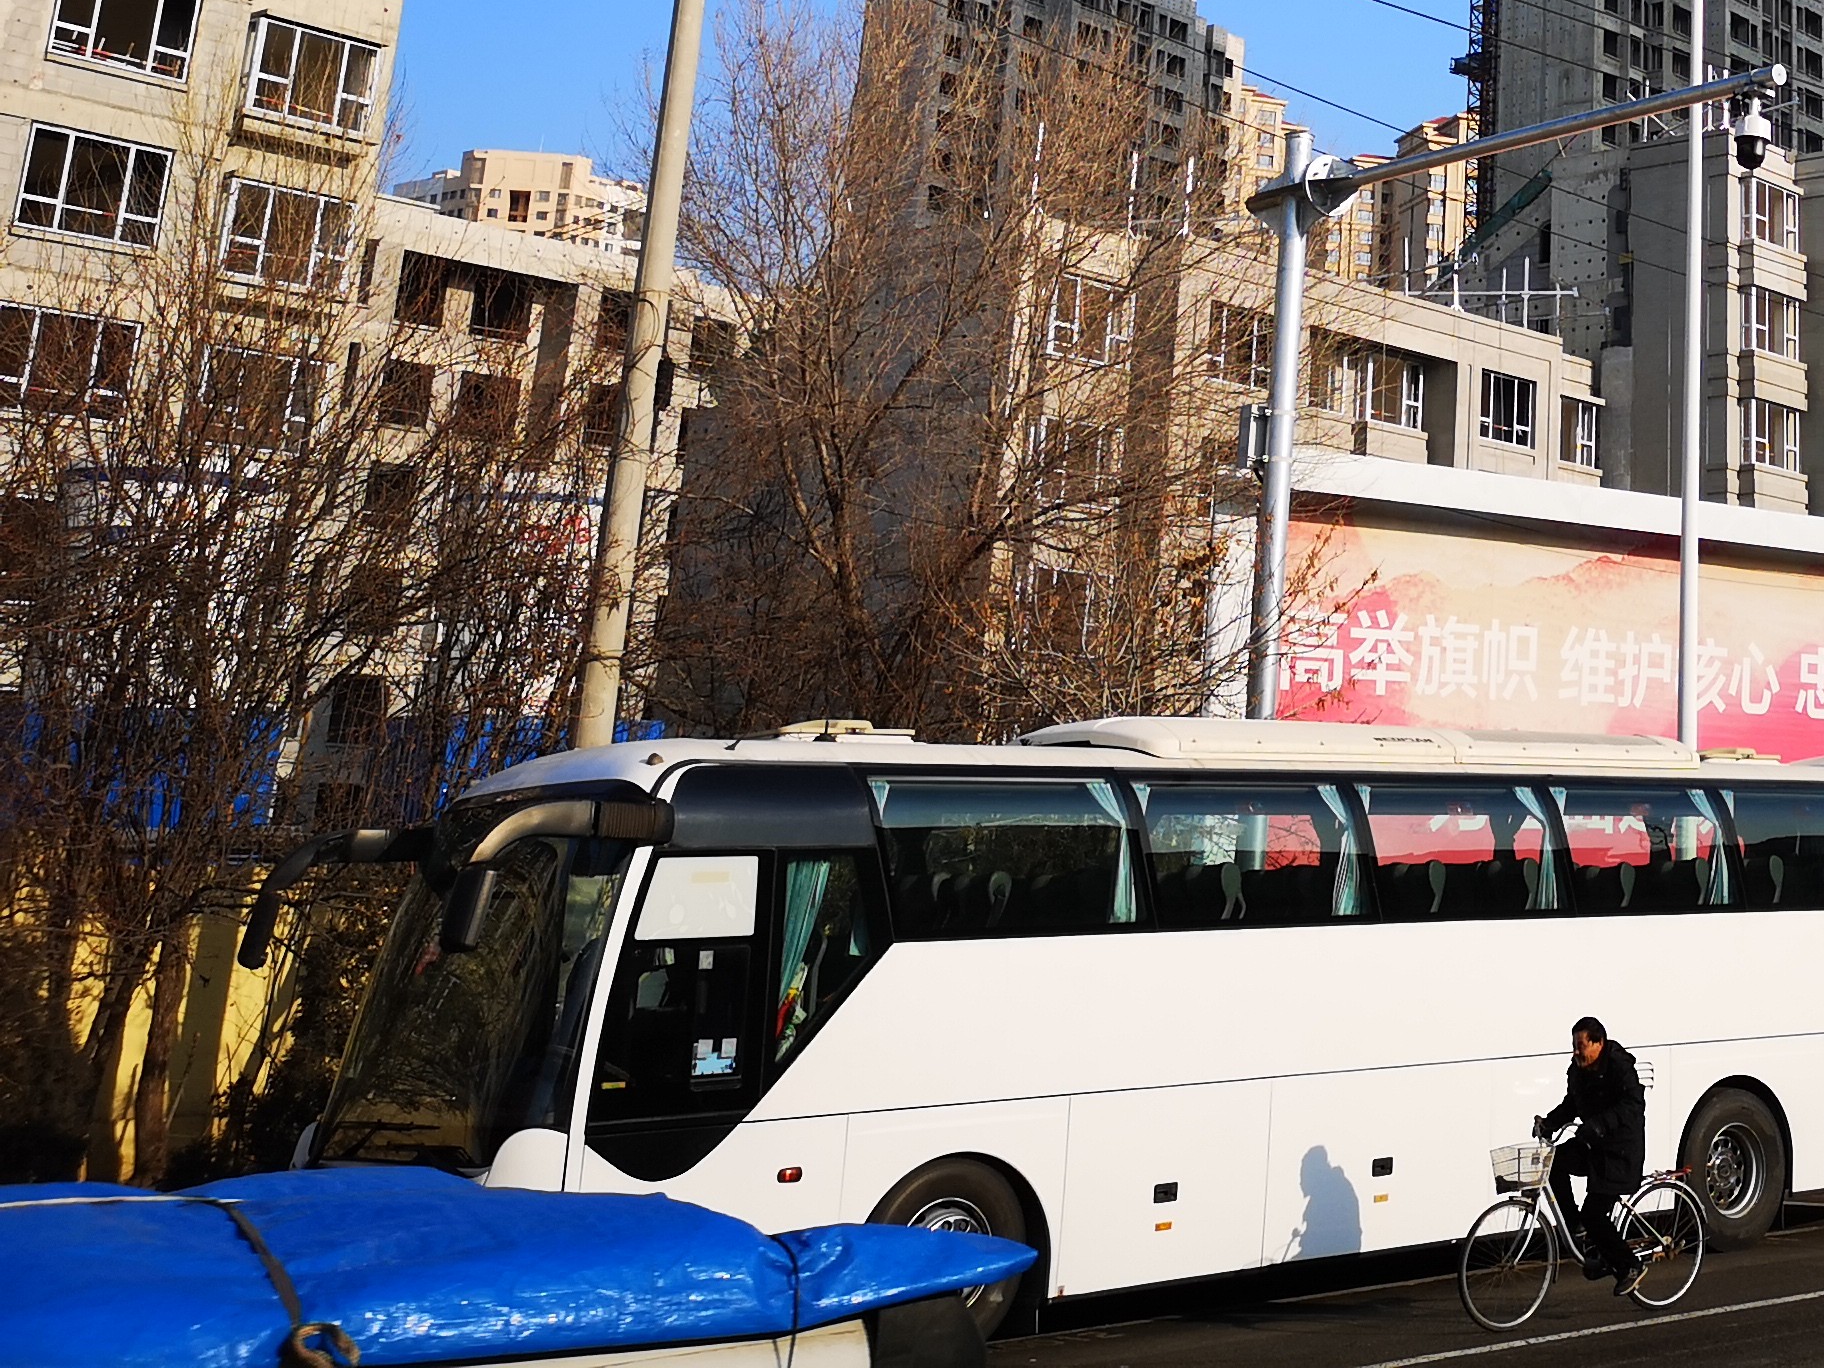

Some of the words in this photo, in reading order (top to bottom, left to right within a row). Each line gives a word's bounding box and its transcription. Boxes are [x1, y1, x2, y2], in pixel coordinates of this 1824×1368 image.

[1279, 609, 1539, 701] 高举旗帜
[1558, 626, 1782, 714] 维护核心
